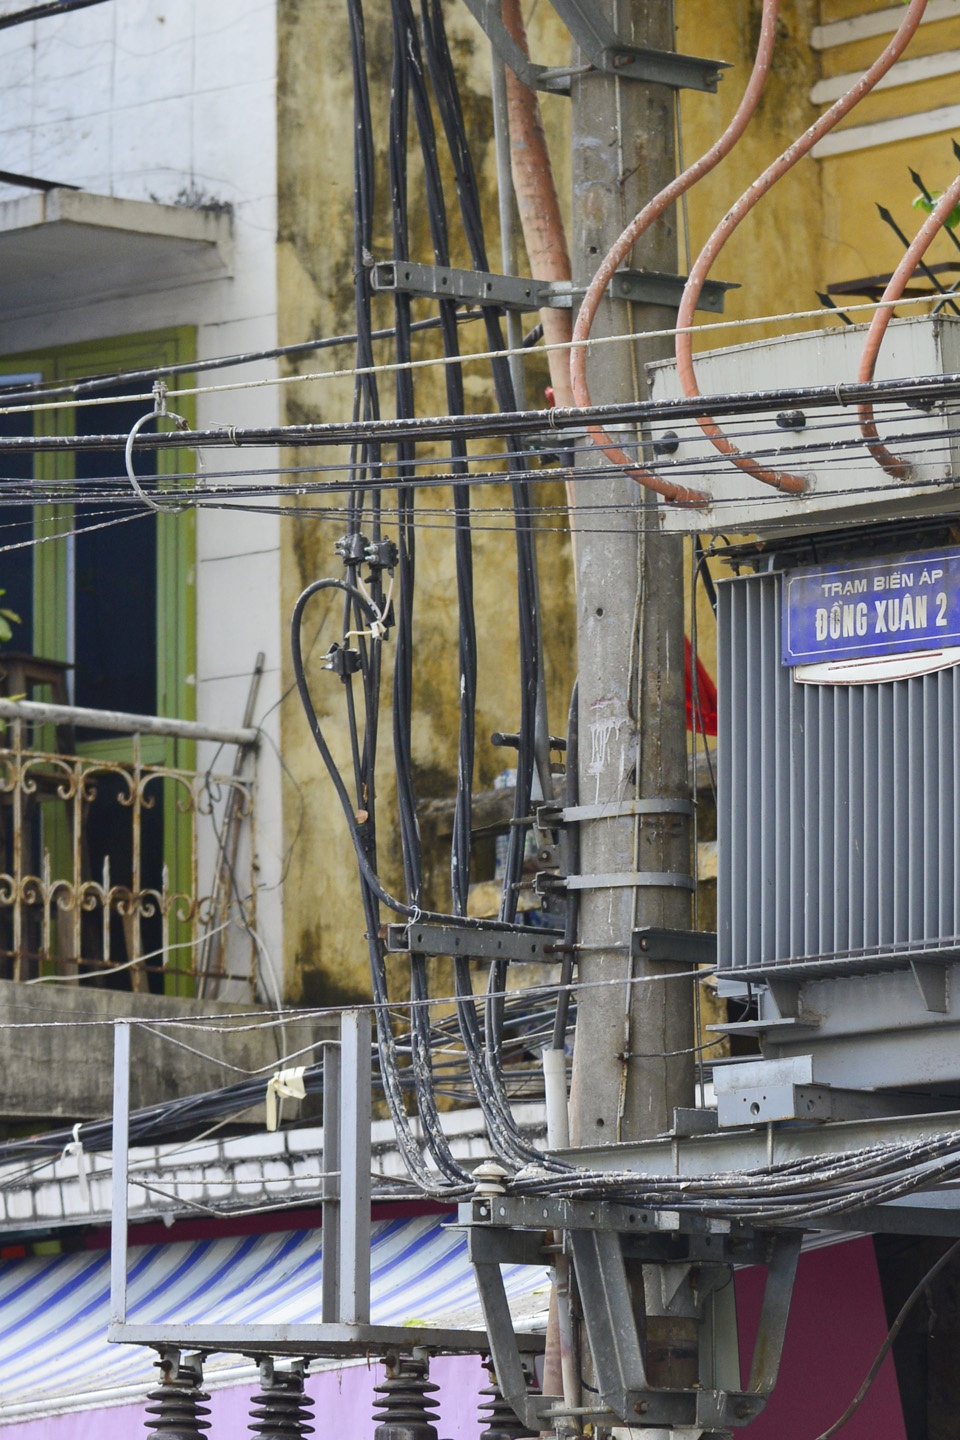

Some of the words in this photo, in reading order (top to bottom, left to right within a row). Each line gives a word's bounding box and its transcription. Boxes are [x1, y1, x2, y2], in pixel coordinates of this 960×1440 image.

[821, 578, 868, 598] TRẠM
[918, 567, 944, 585] ÁP
[815, 600, 868, 642] ĐỒNG
[874, 593, 928, 635] XUÂN
[935, 592, 948, 627] 2
